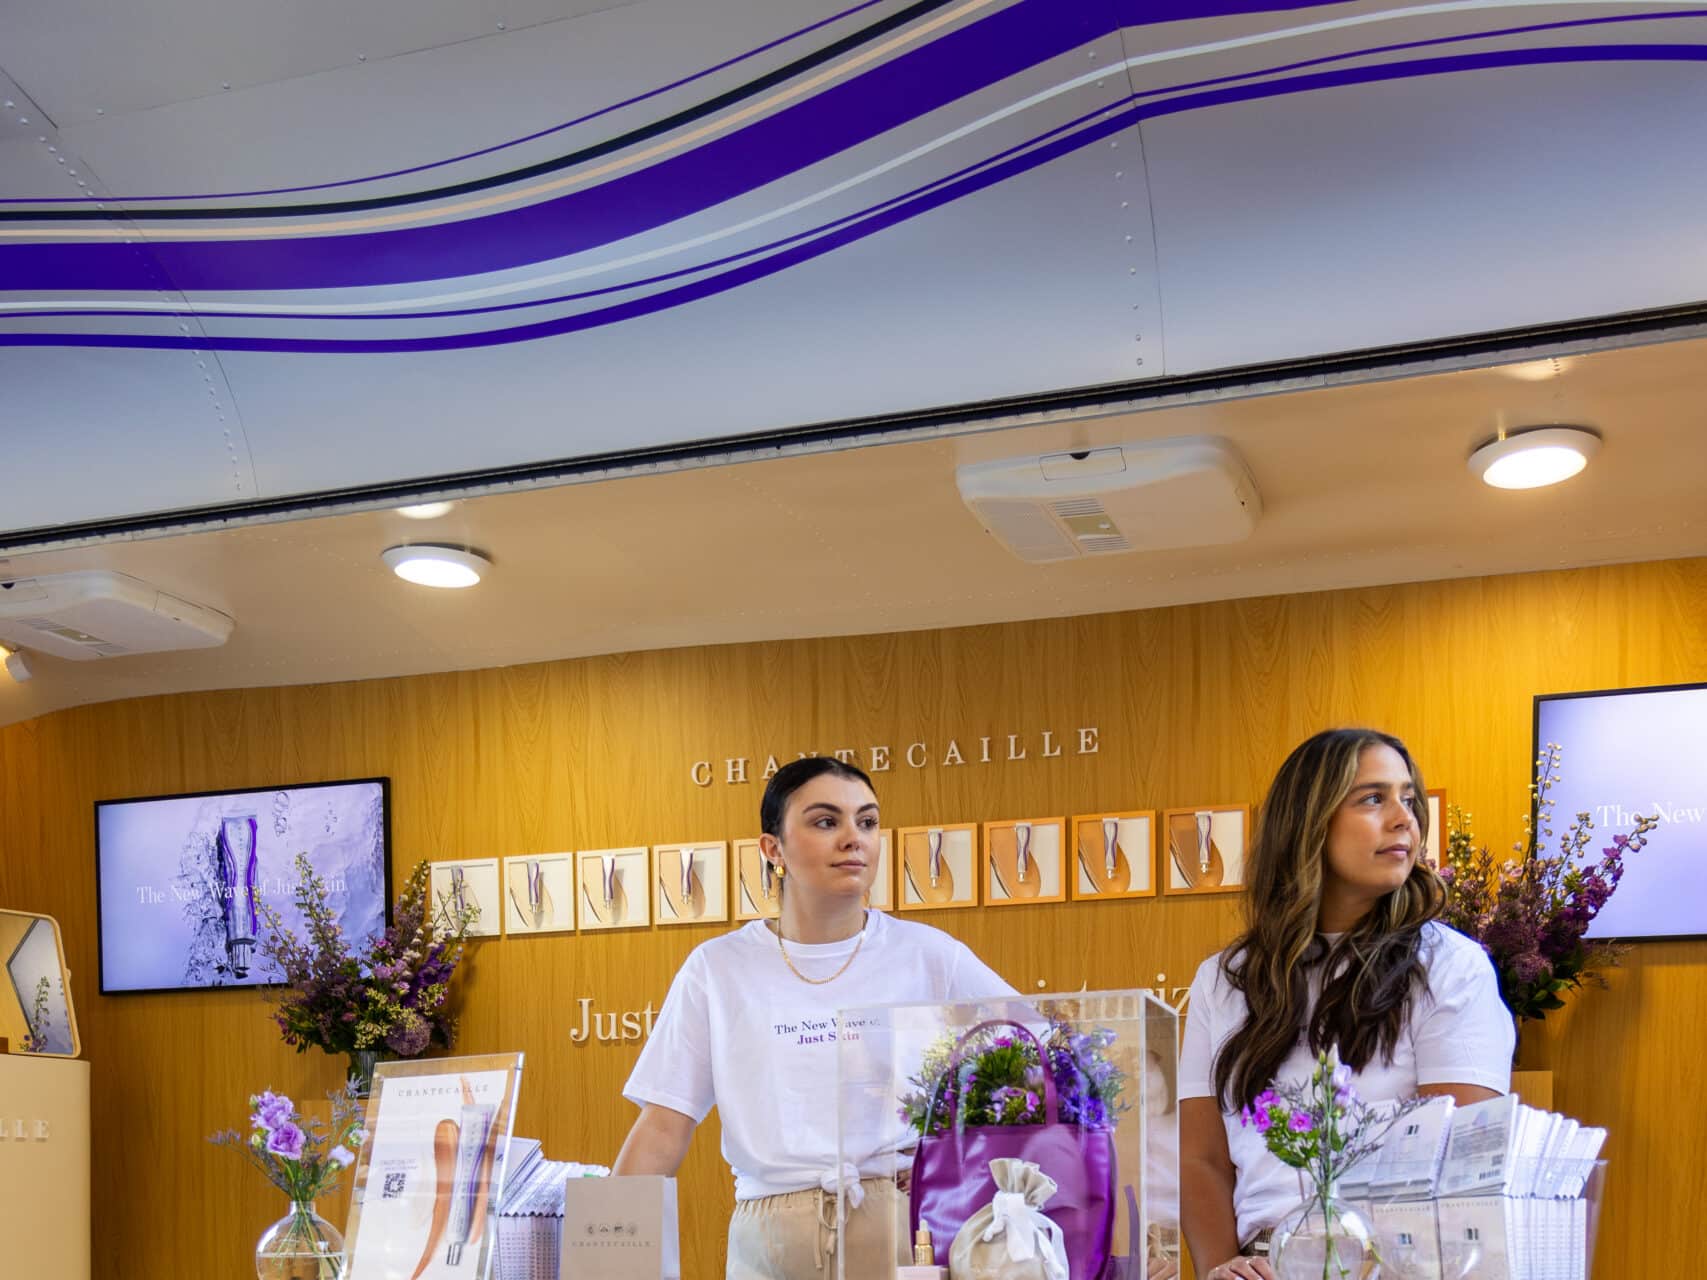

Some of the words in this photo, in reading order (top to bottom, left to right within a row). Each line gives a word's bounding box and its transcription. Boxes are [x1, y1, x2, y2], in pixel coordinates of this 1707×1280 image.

[691, 728, 1098, 785] CHATECAILLE
[1652, 801, 1706, 824] New
[136, 886, 162, 905] The
[170, 884, 201, 903] New
[569, 998, 660, 1042] Just
[774, 1023, 798, 1035] The
[801, 1019, 829, 1031] New
[797, 1033, 825, 1045] Just
